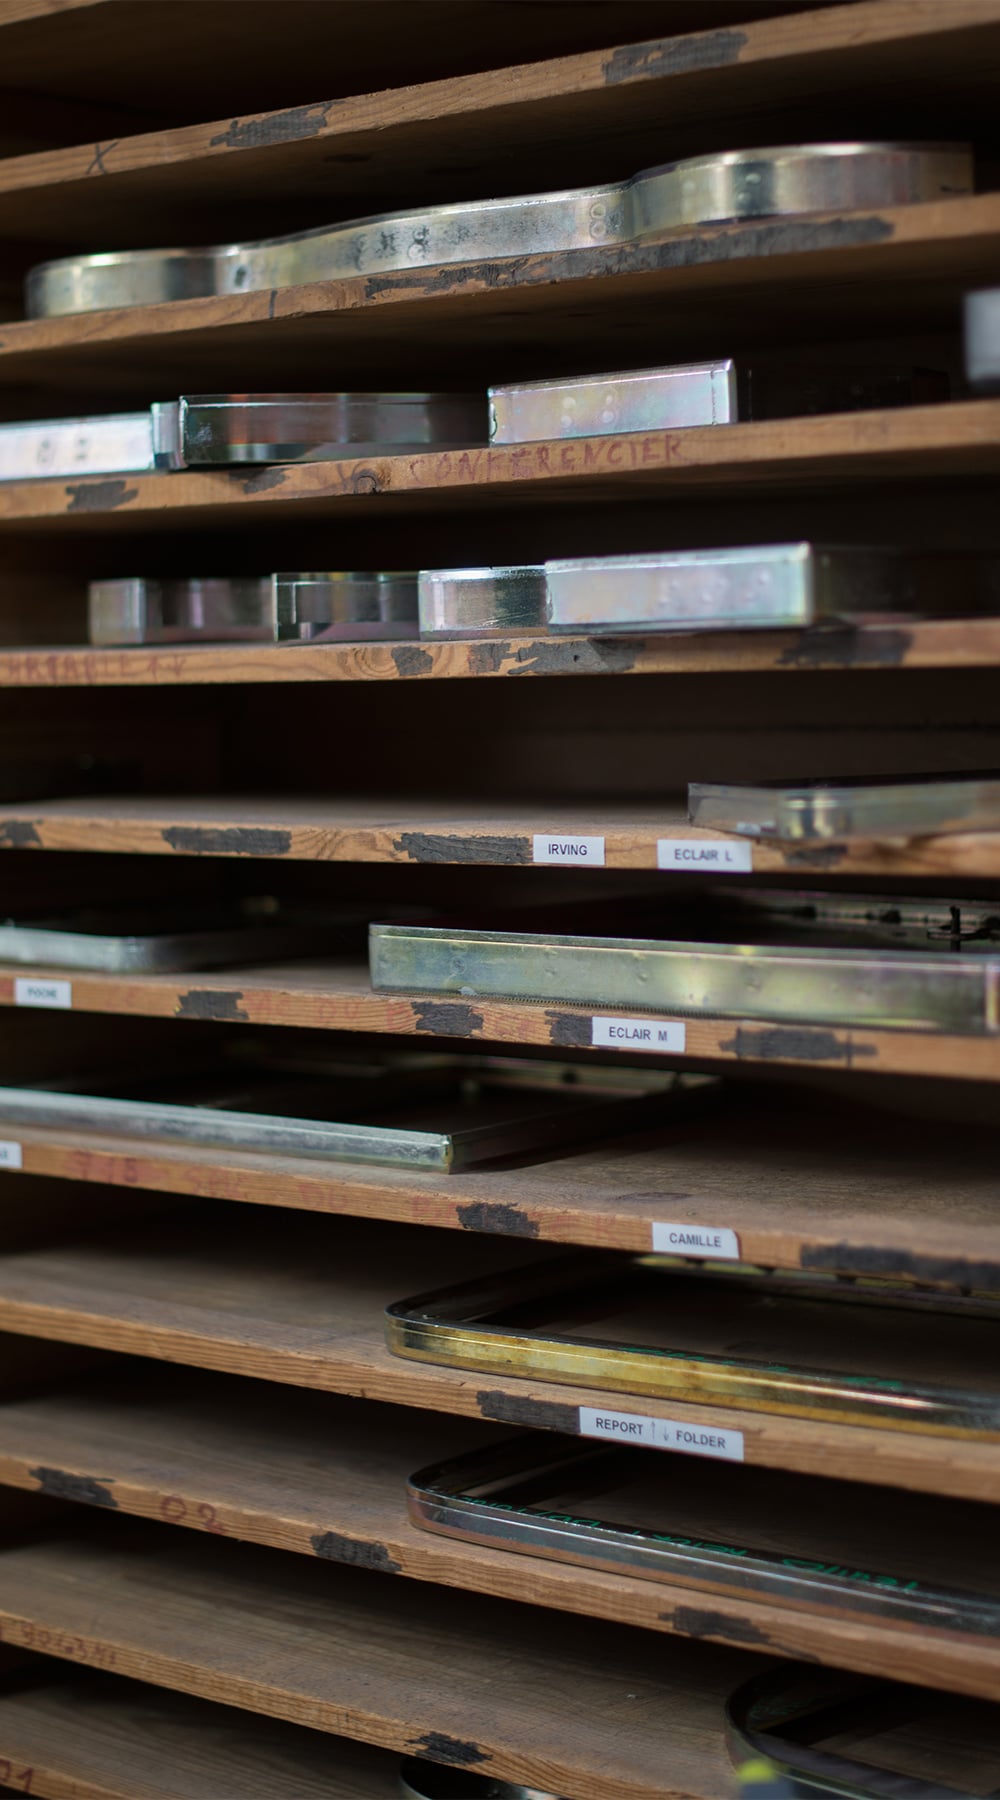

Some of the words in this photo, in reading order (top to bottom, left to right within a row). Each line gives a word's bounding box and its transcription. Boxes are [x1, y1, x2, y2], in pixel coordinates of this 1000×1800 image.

[547, 843, 588, 856] IRVING
[674, 848, 719, 862] ECLAIR
[725, 849, 733, 862] L
[608, 1026, 651, 1041] ECLAIR
[657, 1030, 668, 1042] M
[669, 1232, 722, 1248] CAMILLE
[595, 1417, 644, 1435] REPORT
[676, 1429, 726, 1449] FOLDER
